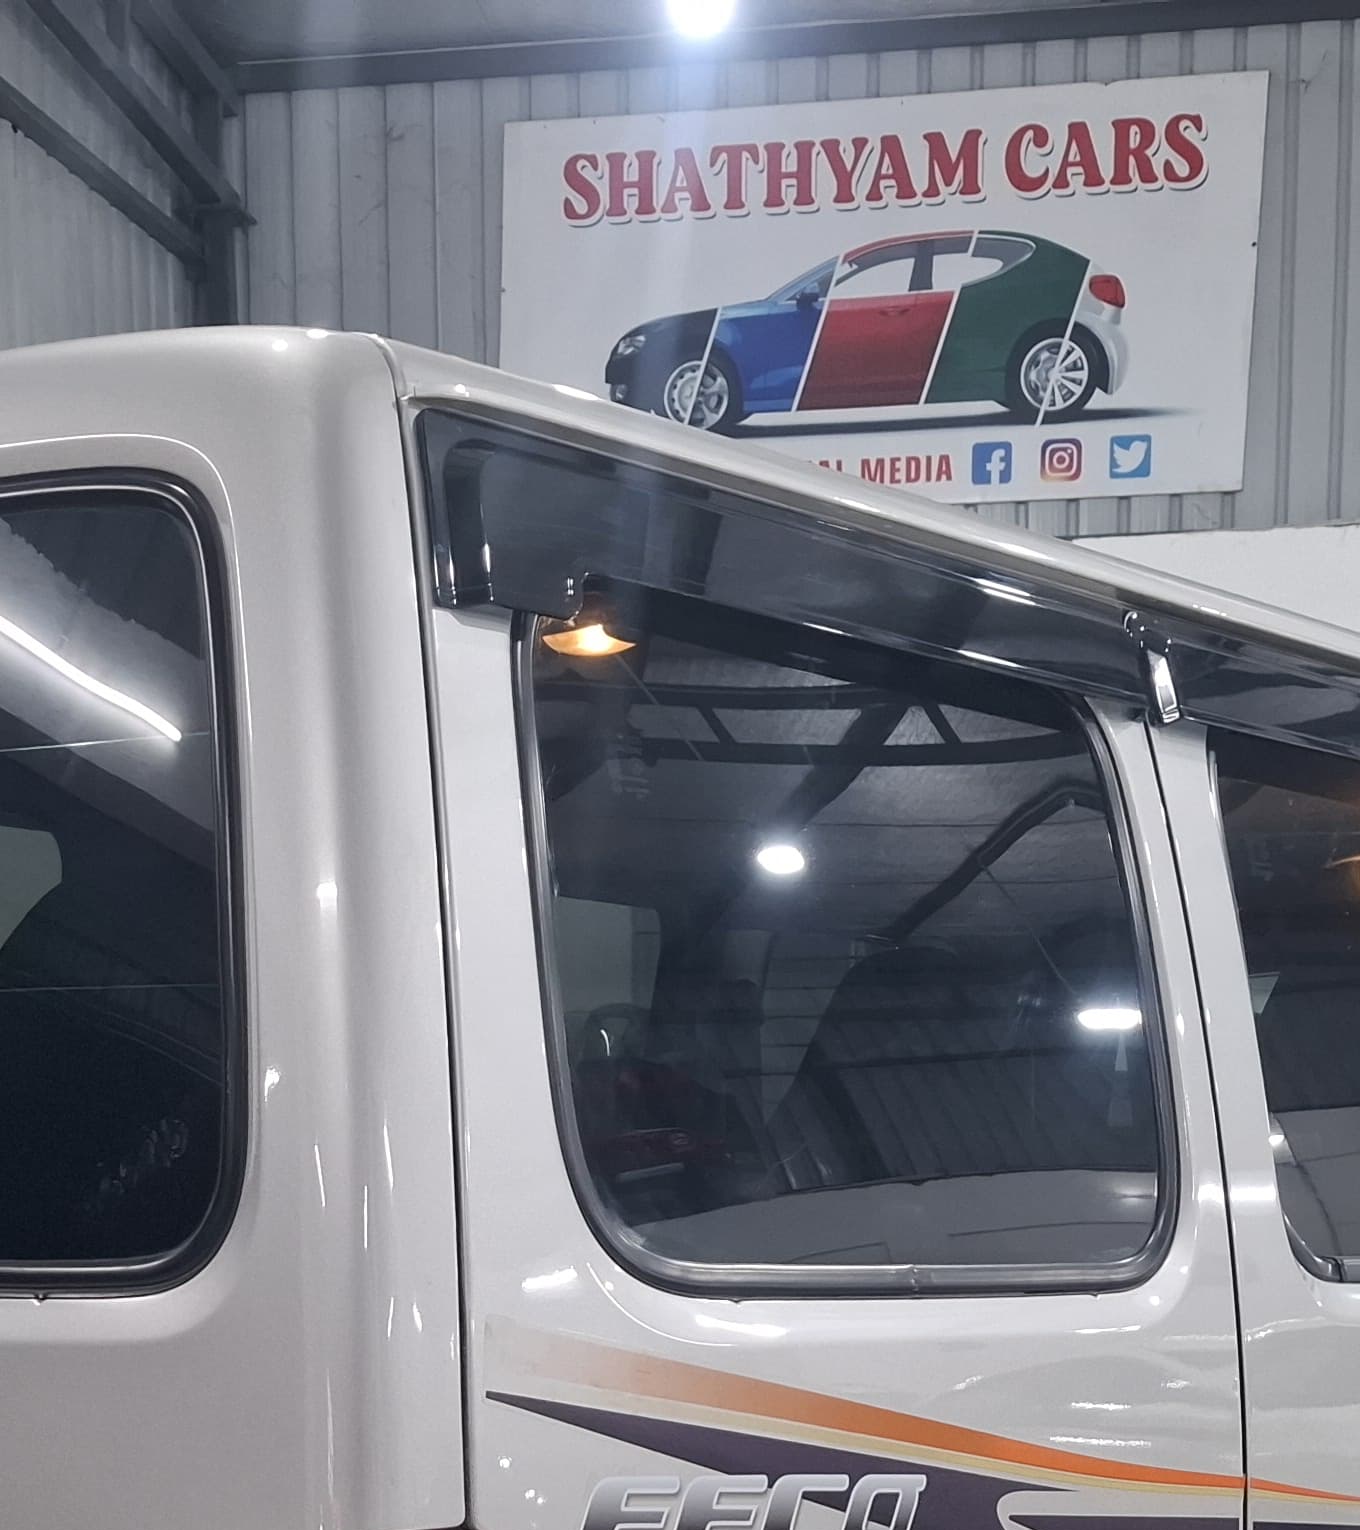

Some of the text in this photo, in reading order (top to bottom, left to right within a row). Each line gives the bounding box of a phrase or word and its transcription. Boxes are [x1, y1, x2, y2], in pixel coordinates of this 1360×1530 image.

[562, 112, 1208, 226] SHATHYAM CARS
[860, 454, 953, 485] MEDIA
